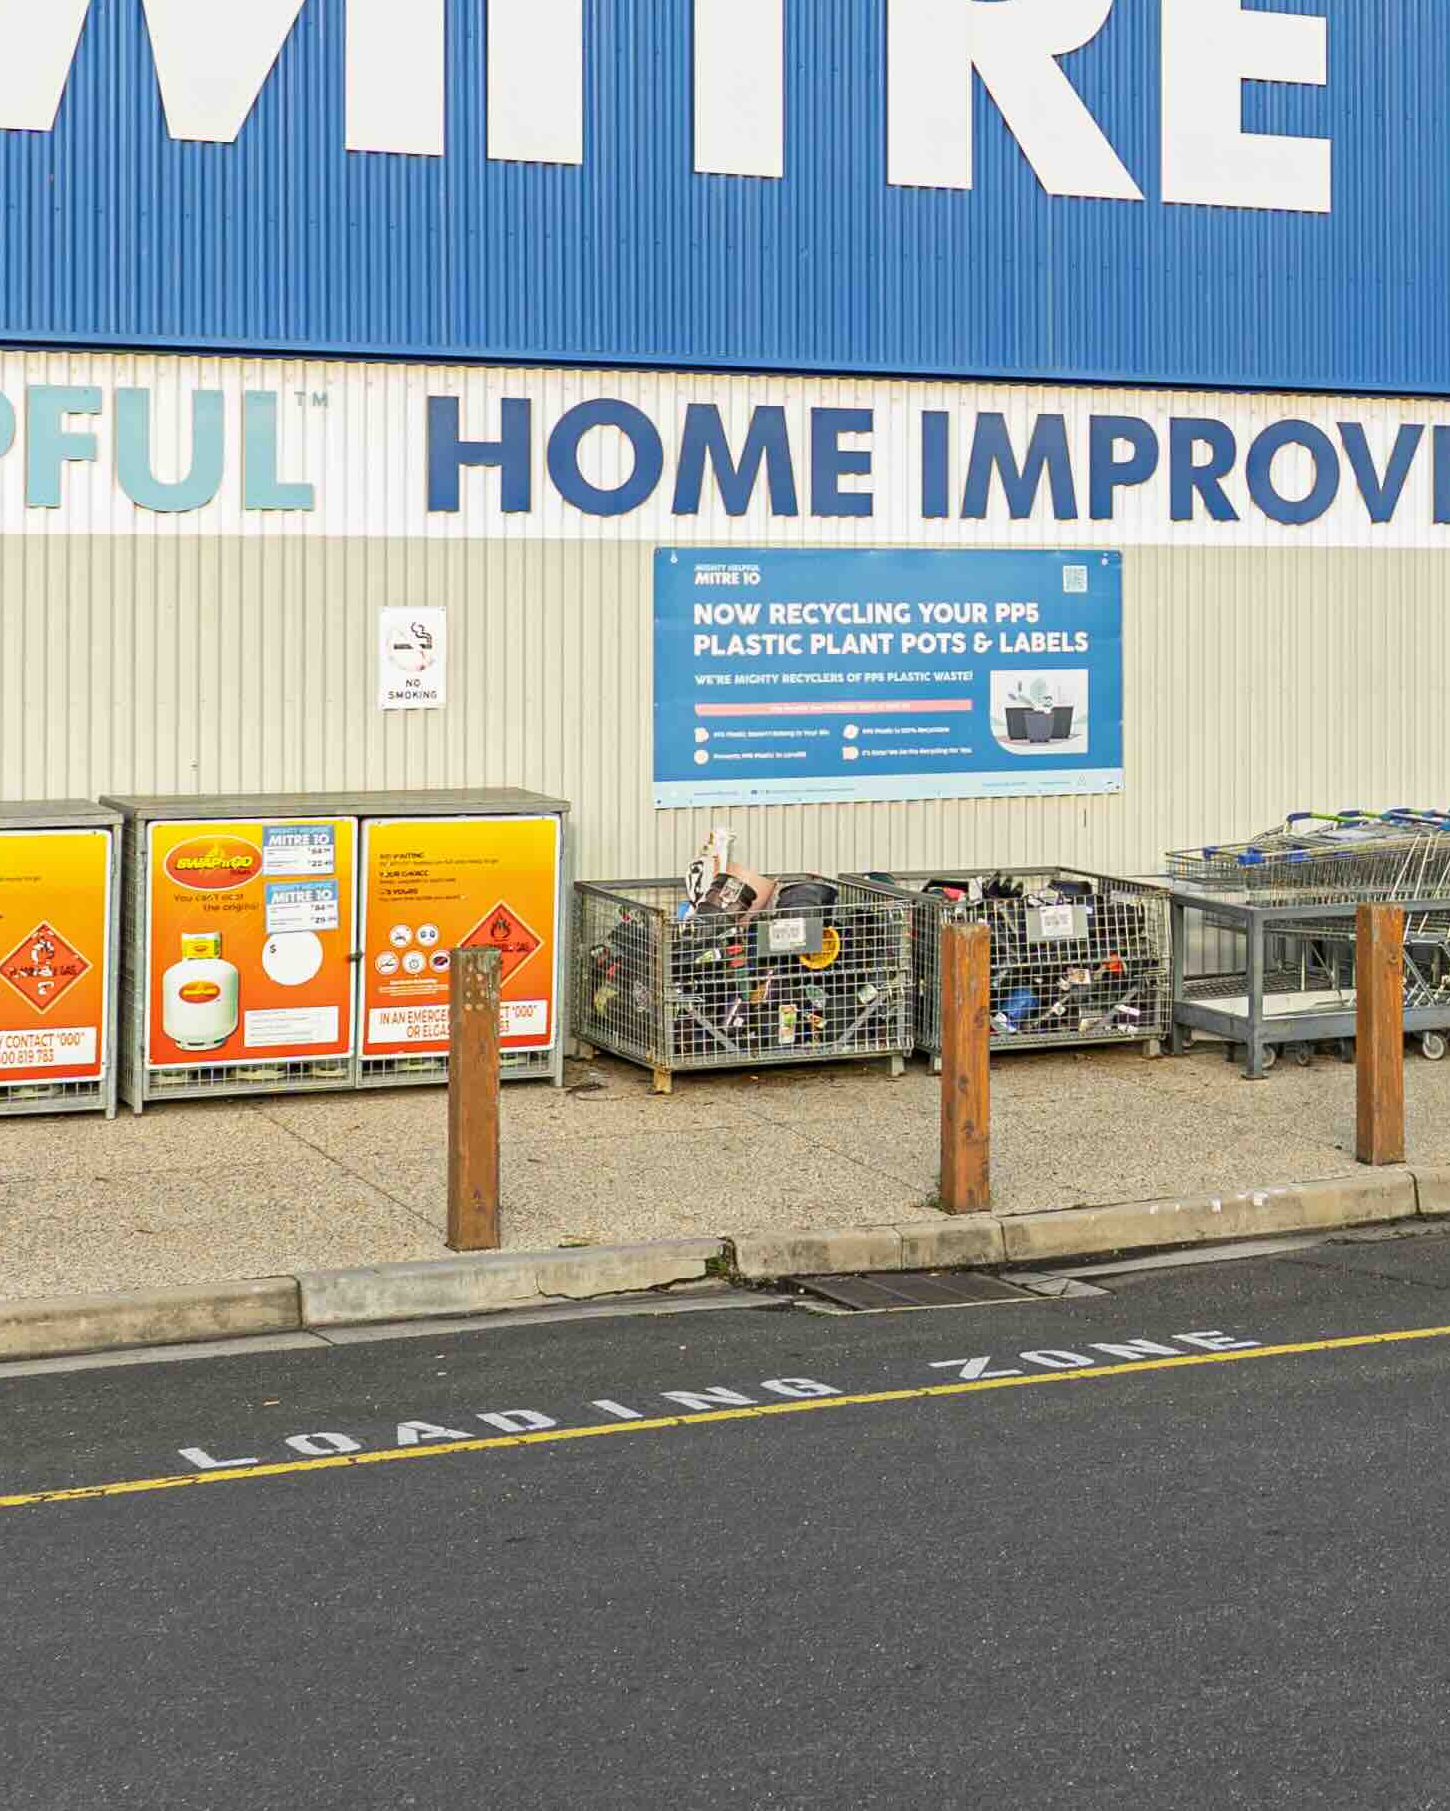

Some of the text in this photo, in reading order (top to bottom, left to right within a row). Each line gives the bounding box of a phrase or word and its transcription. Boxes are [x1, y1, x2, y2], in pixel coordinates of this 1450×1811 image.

[426, 396, 873, 516] HOME
[694, 572, 761, 585] MITRE 10
[693, 602, 1039, 625] NOW RECYCLING YOUR PP5
[693, 632, 1089, 656] PLASTIC PLANT POTS & LABELS
[405, 679, 421, 687] NO
[694, 674, 731, 686] WE'RE
[734, 674, 779, 685] MIGHTY
[782, 673, 845, 684] RECYCLERS
[847, 672, 862, 683] OF
[888, 671, 930, 682] PLASTIC
[387, 690, 437, 700] SMOKING
[269, 834, 329, 847] MITRE 10
[174, 893, 193, 902] You
[272, 890, 333, 904] MITRE 10
[391, 1010, 406, 1023] AN
[406, 1025, 421, 1038] OR
[5, 1033, 54, 1049] CONTACT
[178, 1328, 1262, 1471] LOADING ZONE
